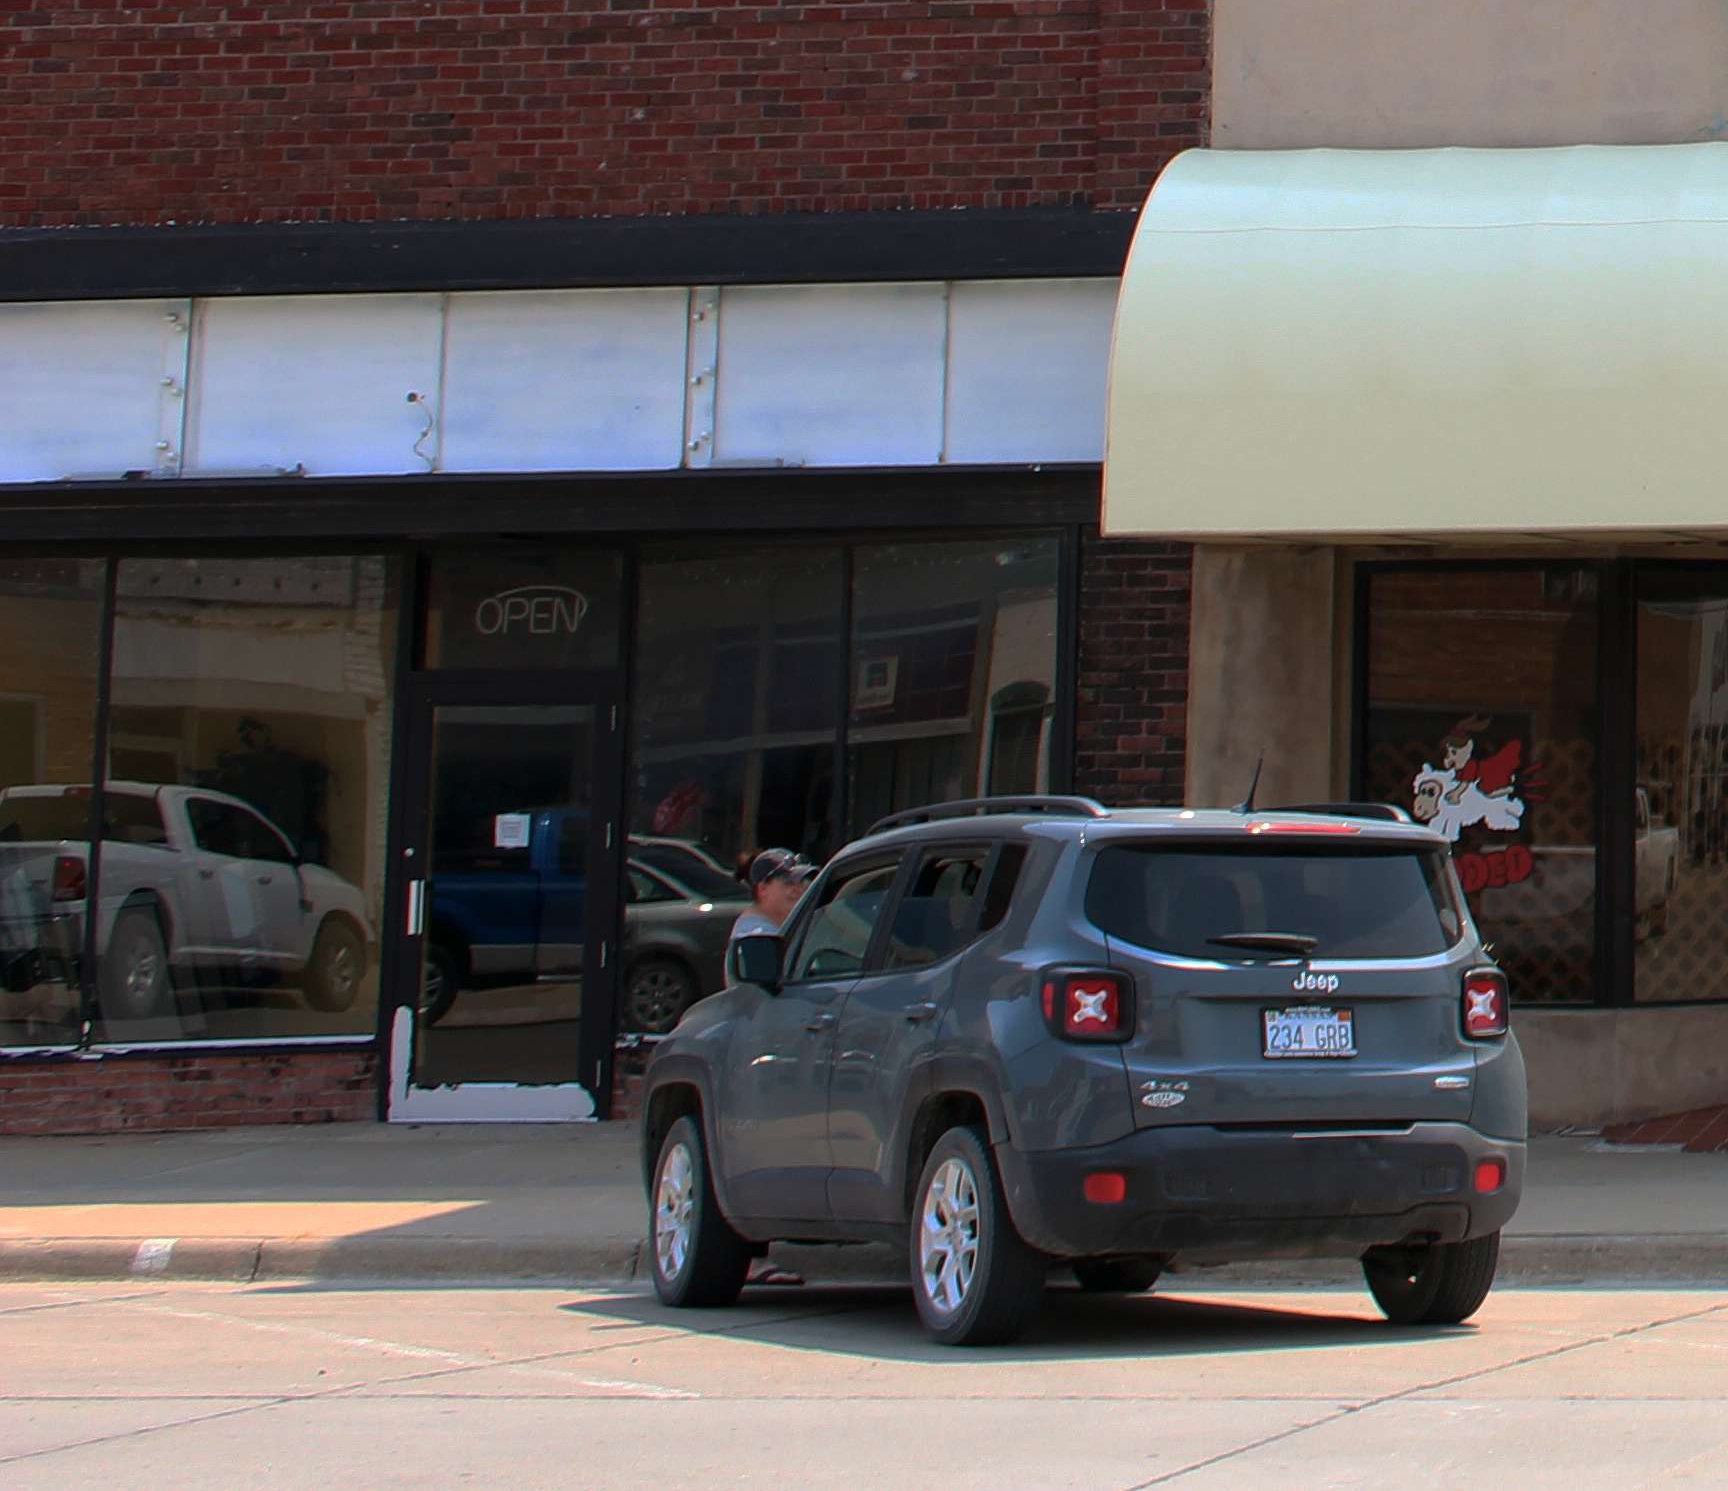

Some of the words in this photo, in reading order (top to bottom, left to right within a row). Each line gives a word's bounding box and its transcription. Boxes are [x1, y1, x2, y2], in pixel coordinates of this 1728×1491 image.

[475, 597, 581, 635] OPEN
[1292, 971, 1340, 994] Jeep
[1269, 1024, 1305, 1051] 234
[1314, 1023, 1350, 1051] GRB
